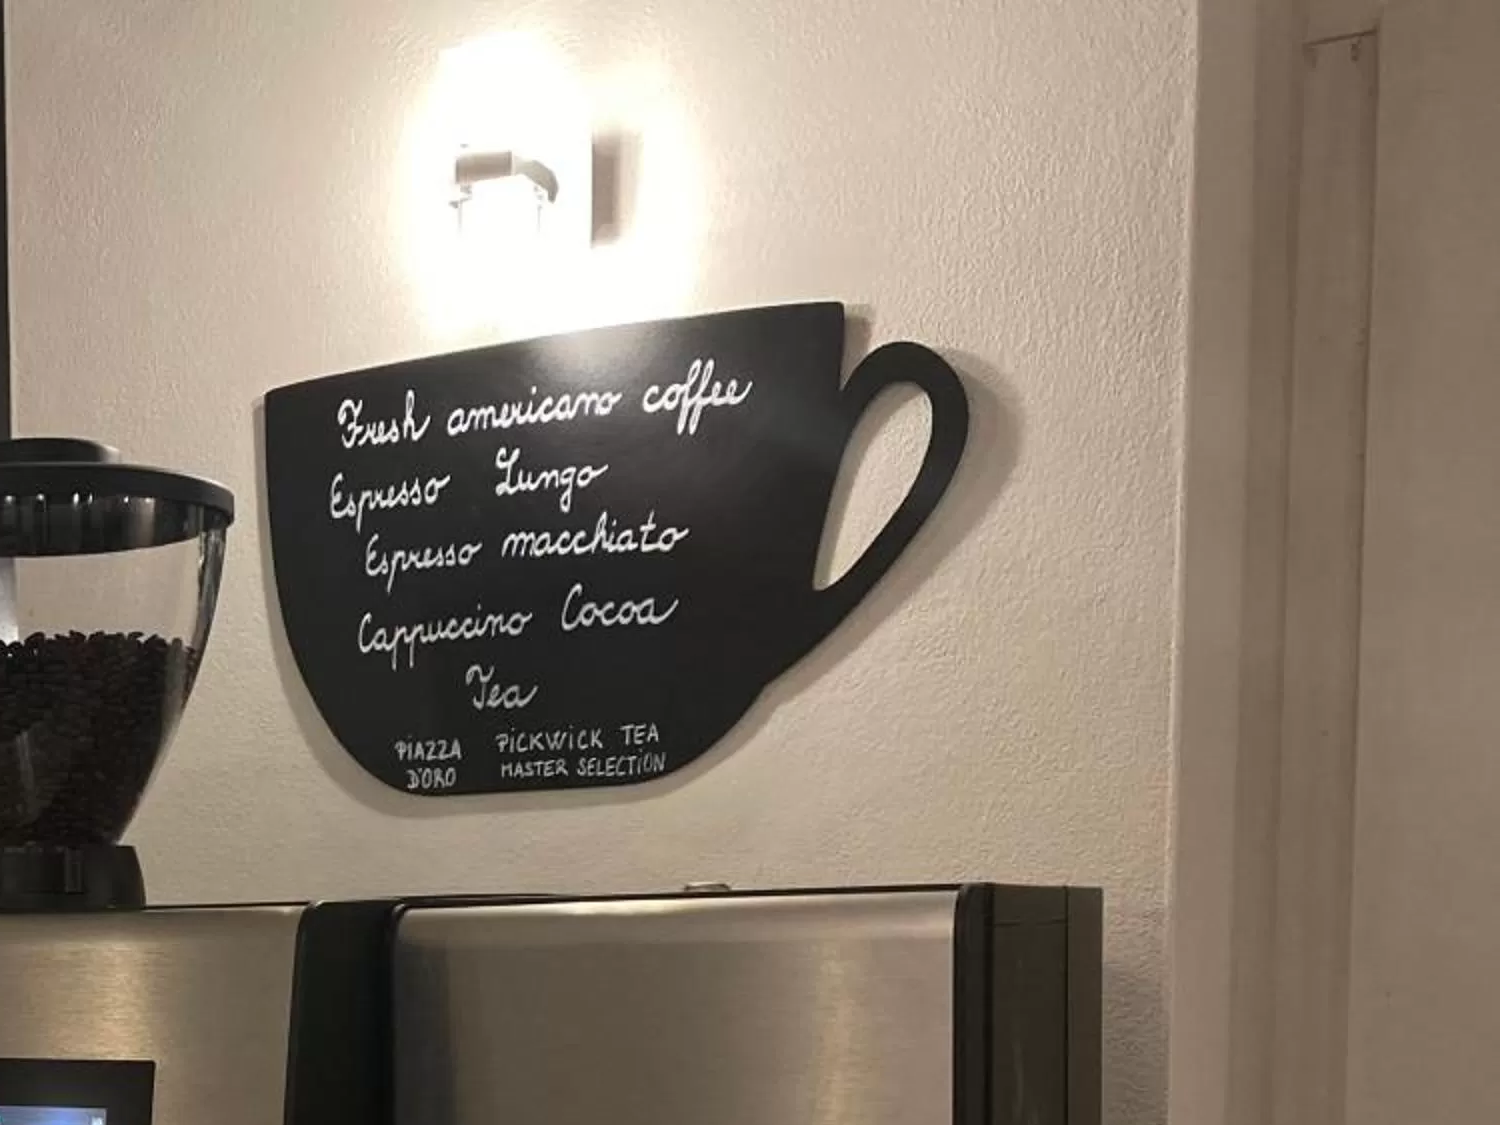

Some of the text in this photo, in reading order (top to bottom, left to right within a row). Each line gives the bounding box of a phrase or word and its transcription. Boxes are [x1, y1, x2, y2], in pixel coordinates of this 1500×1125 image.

[337, 358, 753, 448] Fresh americano coffee
[330, 447, 609, 533] Espresso Lungo
[366, 510, 690, 594] Espresso macchiato
[358, 583, 679, 671] Cappuccino Cocoa
[465, 664, 539, 709] Tea
[501, 759, 569, 779] MASTER
[620, 722, 660, 746] TEA
